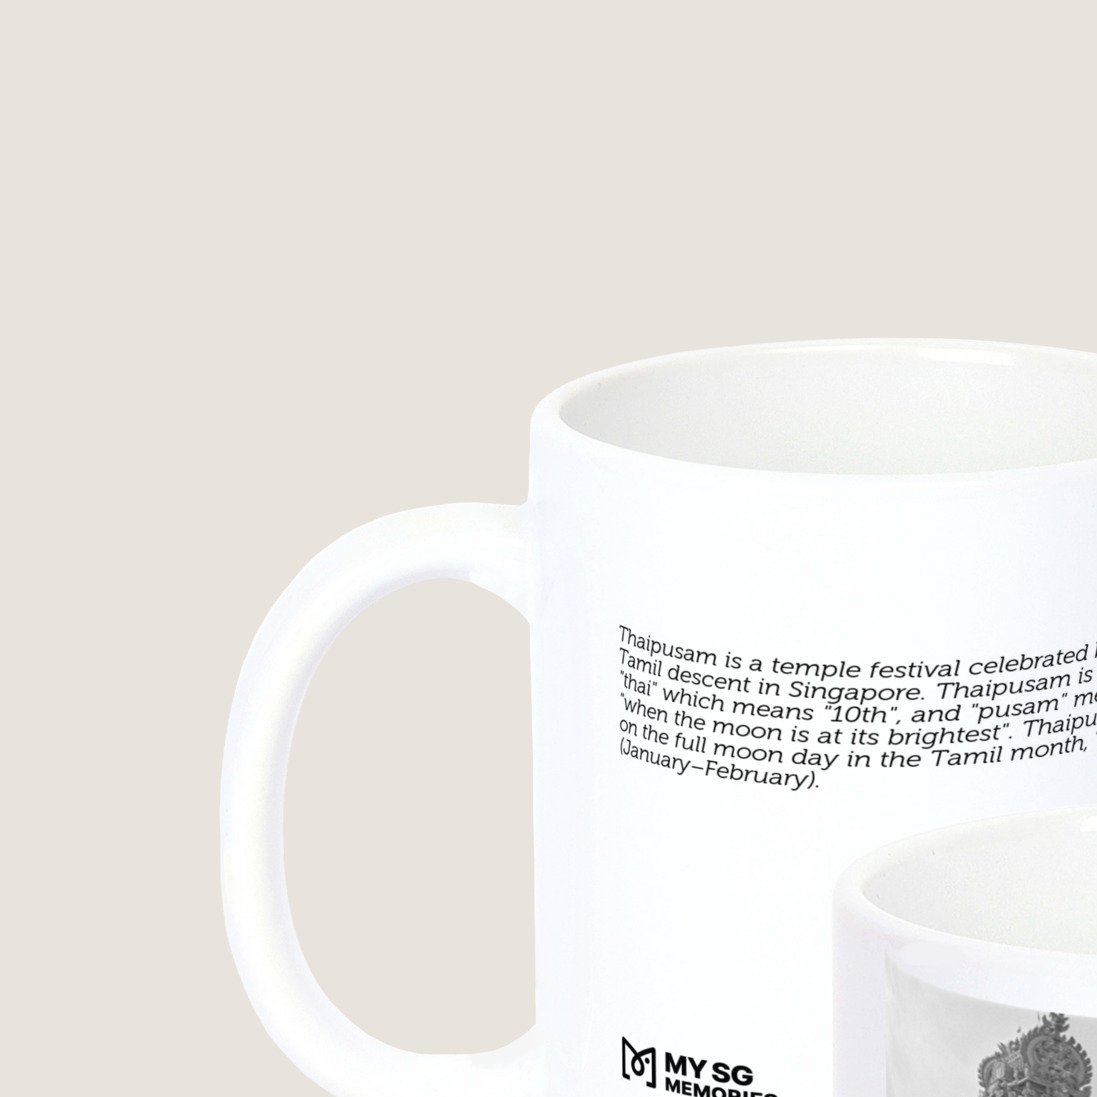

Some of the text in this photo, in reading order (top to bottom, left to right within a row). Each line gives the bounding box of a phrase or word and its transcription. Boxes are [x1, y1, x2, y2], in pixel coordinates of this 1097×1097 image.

[619, 625, 716, 666] Thaipusam
[725, 652, 742, 669] is
[749, 659, 762, 672] a
[773, 658, 861, 681] temple
[870, 660, 960, 678] festival
[969, 644, 1088, 675] celebrated
[620, 648, 662, 677] Tamil
[668, 665, 751, 694] descent
[759, 678, 779, 696] in
[789, 681, 924, 705] Singapore.
[937, 674, 1070, 701] Thaipusam
[1079, 667, 1093, 684] is
[621, 670, 657, 697] "thai"
[663, 688, 724, 712] which
[733, 701, 814, 720] means
[825, 705, 900, 725] "10th",
[911, 704, 961, 722] and
[972, 693, 1067, 724] "pusam"
[621, 693, 667, 723] "when
[675, 711, 705, 730] the
[713, 721, 781, 741] moon
[791, 726, 809, 742] is
[818, 729, 843, 744] at
[851, 729, 879, 745] its
[888, 723, 1012, 749] brightest".
[620, 720, 637, 736] on
[643, 724, 669, 745] the
[675, 733, 706, 753] full
[714, 743, 782, 763] moon
[792, 749, 839, 770] day
[848, 751, 870, 767] in
[881, 751, 921, 767] the
[932, 746, 1002, 766] Tamil
[1010, 737, 1088, 761] month,
[665, 1052, 753, 1086] MY SG
